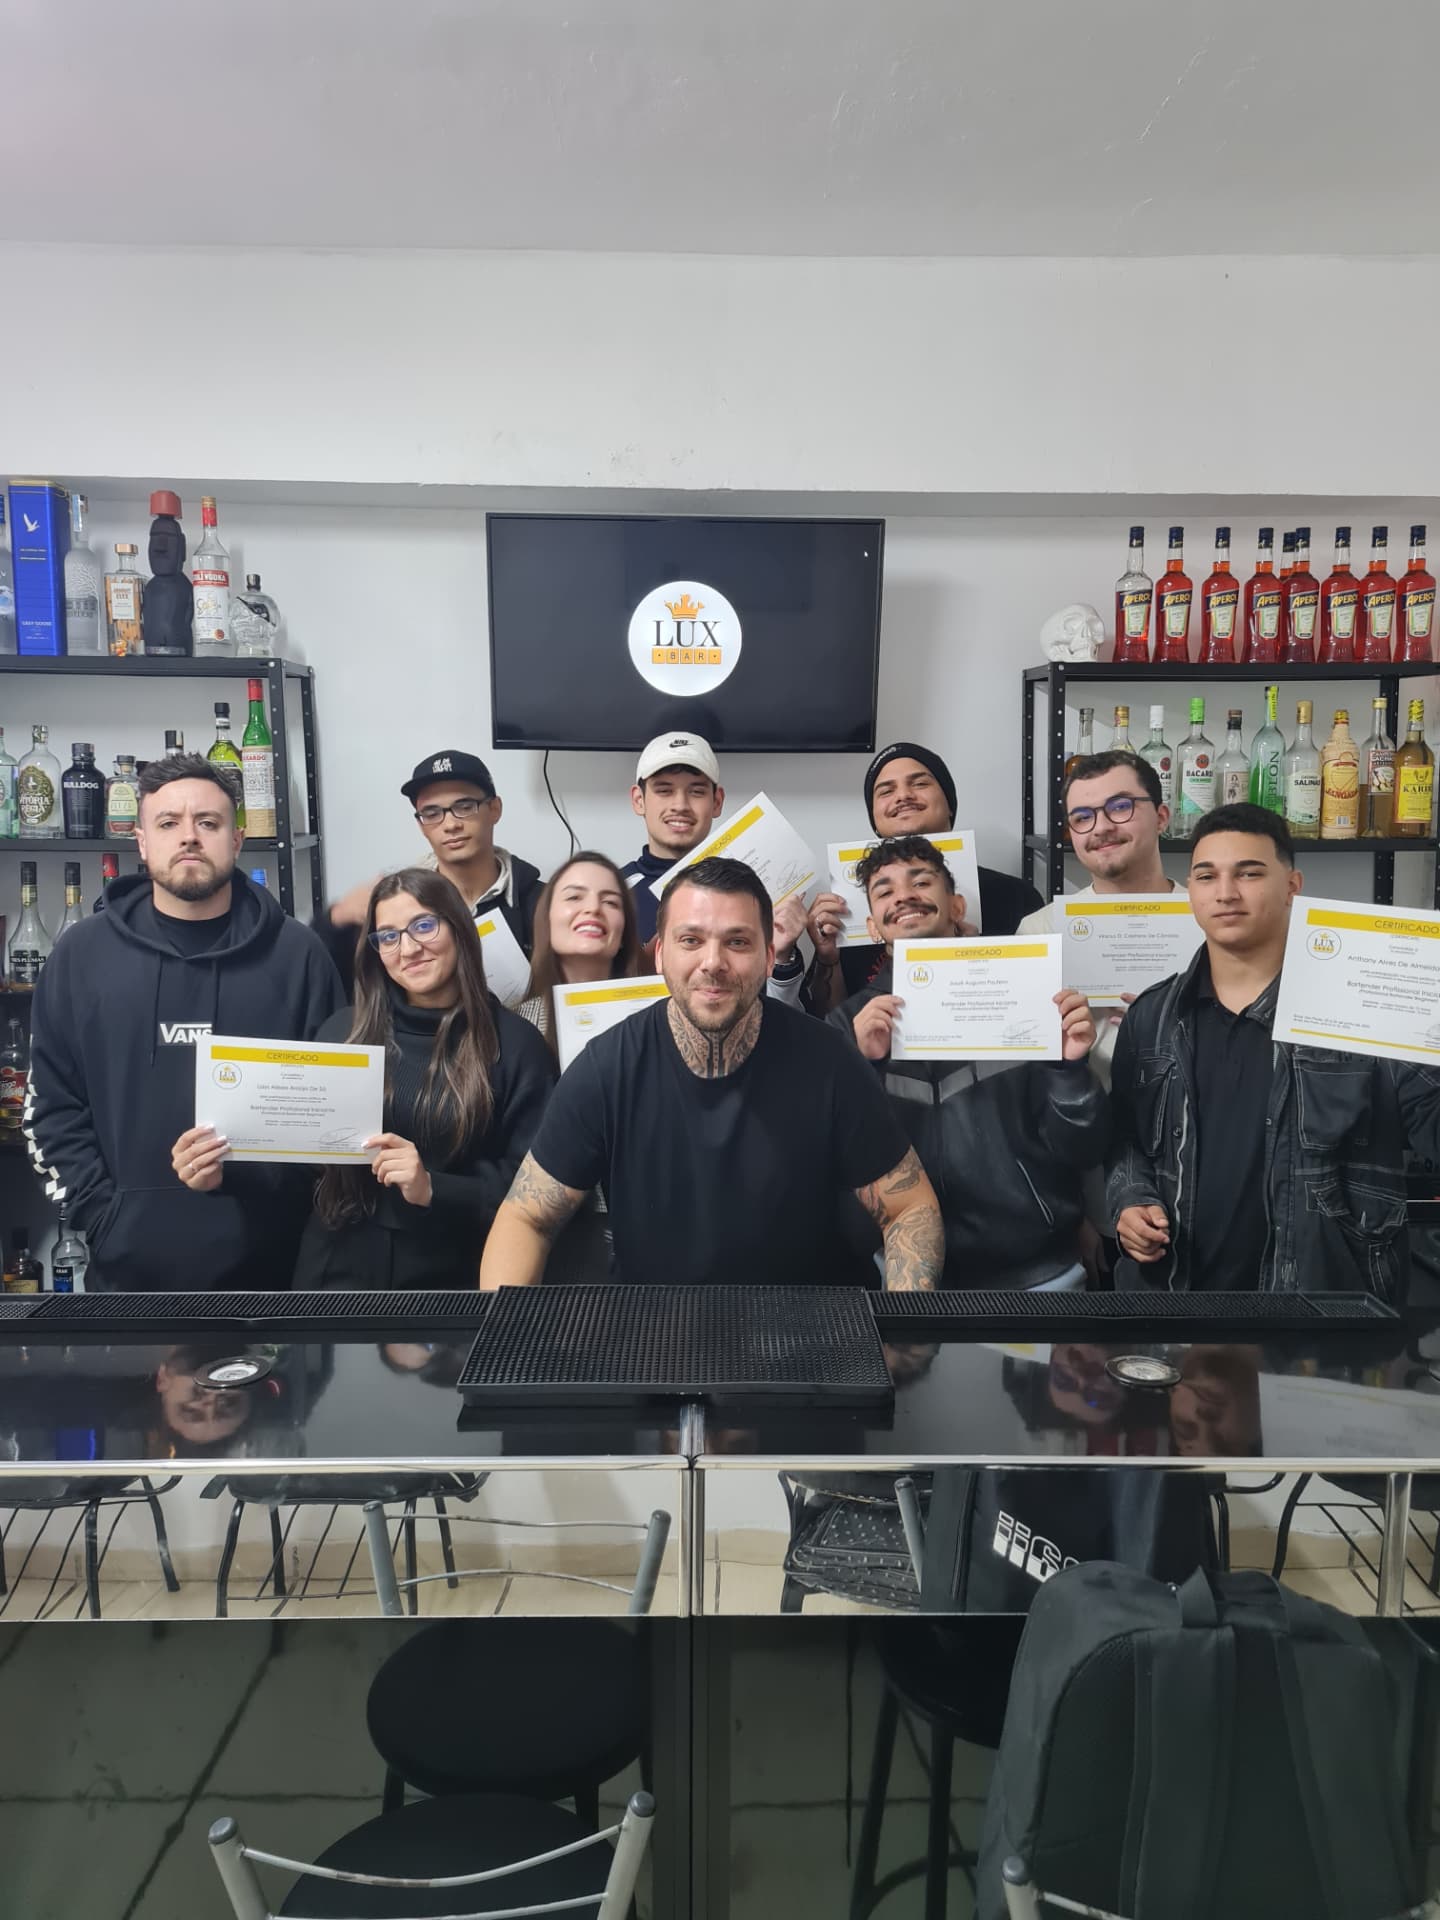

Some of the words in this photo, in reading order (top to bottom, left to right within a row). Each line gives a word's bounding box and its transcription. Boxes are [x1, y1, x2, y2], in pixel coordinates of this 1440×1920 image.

[1123, 593, 1151, 607] APERO
[1164, 593, 1190, 607] APERO
[1257, 594, 1280, 608] APER
[1292, 594, 1318, 608] APERO
[1330, 593, 1357, 607] APERO
[1368, 593, 1394, 608] APERO
[653, 620, 721, 647] LUX
[63, 781, 99, 789] BULLDOG
[1374, 919, 1440, 934] CERTIFICADO
[1313, 938, 1335, 947] LUX
[954, 949, 1002, 957] CERTIFICADO
[266, 1052, 319, 1062] CERTIFICADO
